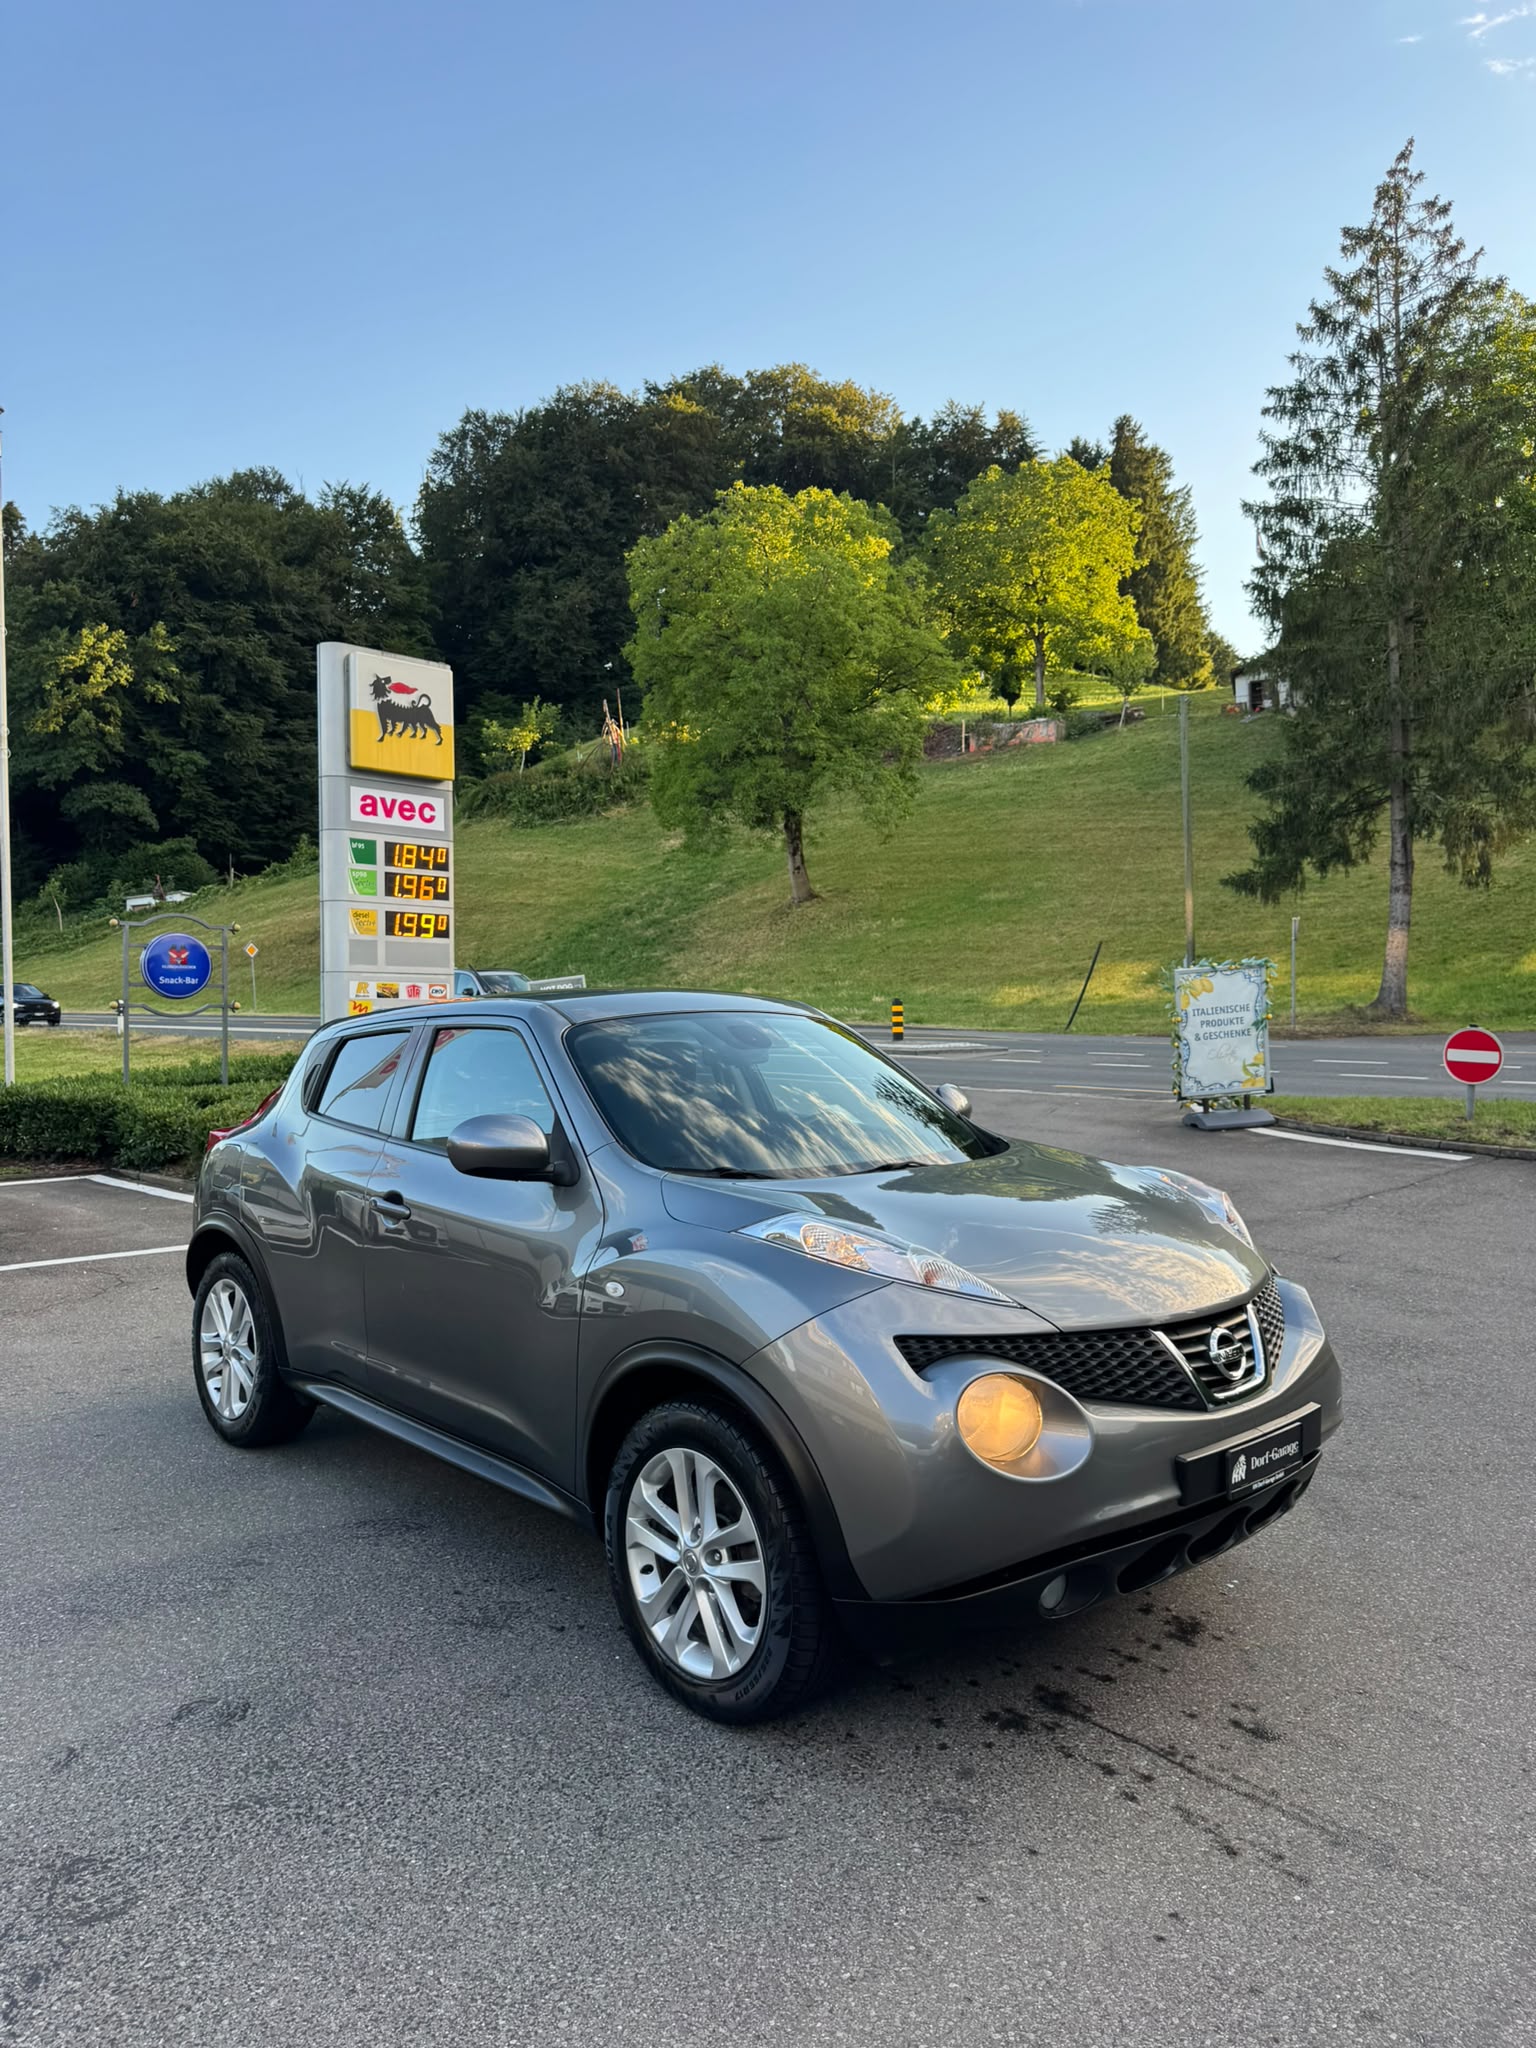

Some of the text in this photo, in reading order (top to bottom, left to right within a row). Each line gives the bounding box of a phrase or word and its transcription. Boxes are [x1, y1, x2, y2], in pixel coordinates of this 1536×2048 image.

[359, 794, 437, 825] avec
[159, 976, 199, 984] Snack-Bar
[1192, 1003, 1250, 1017] ITALIENISCHE
[1200, 1017, 1245, 1028] PRODUKTE
[1194, 1028, 1252, 1041] & GESCHENKE
[1250, 1440, 1299, 1470] Dorf-Garage
